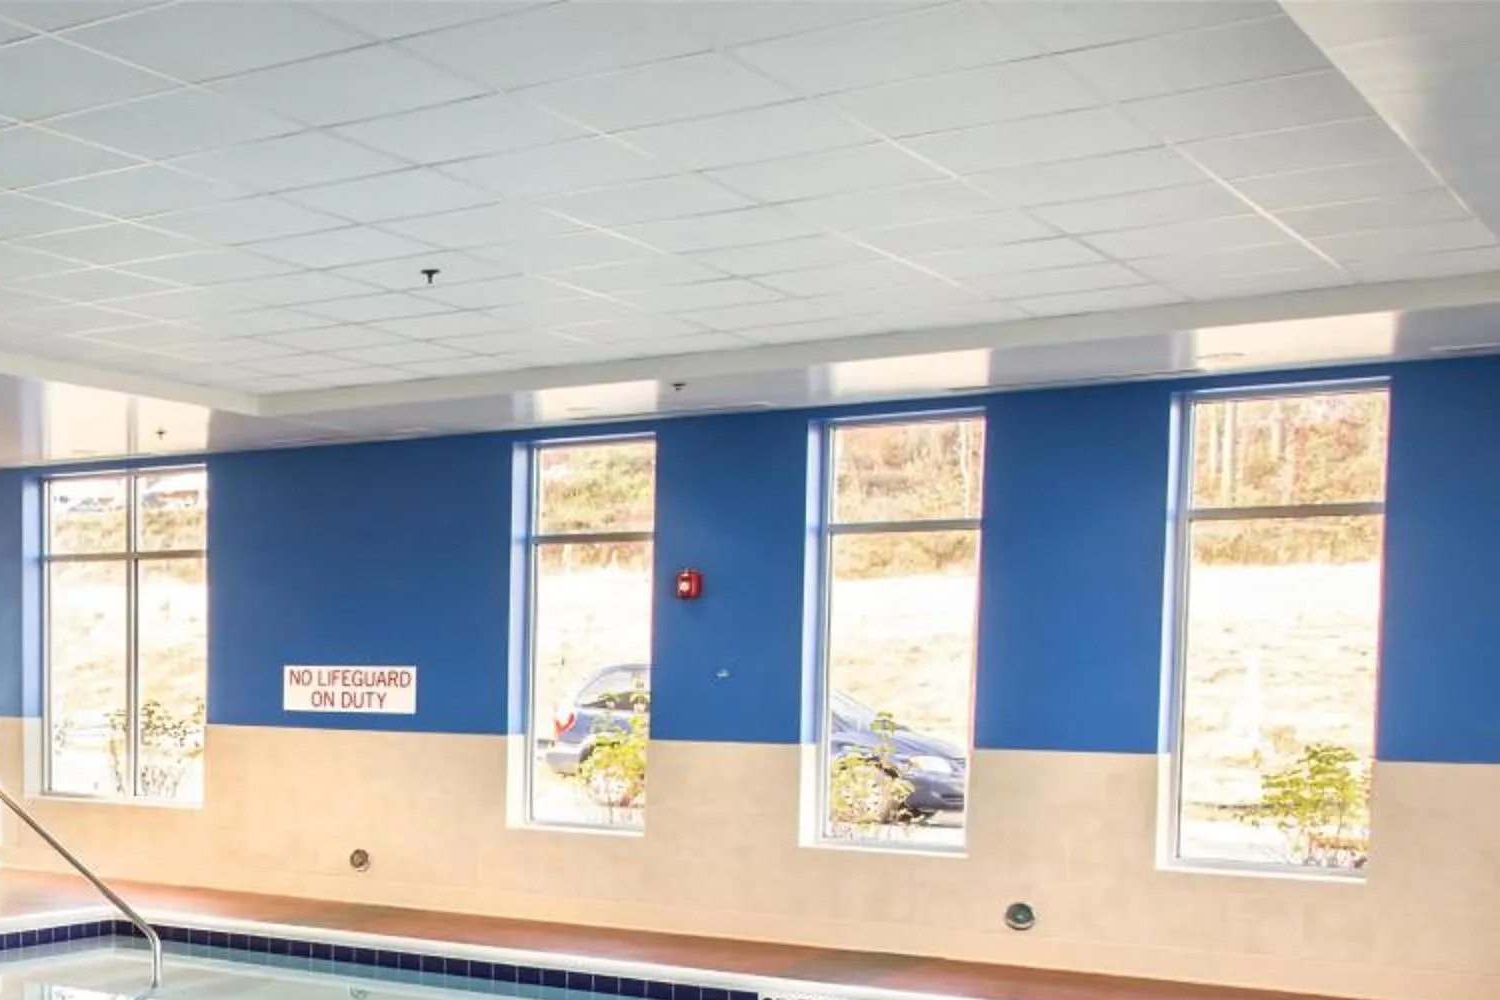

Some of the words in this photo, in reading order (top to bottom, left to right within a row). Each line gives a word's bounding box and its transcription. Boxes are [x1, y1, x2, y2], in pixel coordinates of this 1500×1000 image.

[289, 669, 312, 686] NO
[317, 669, 412, 688] LIFEGUARD
[311, 691, 334, 707] ON
[341, 691, 387, 709] DUTY
